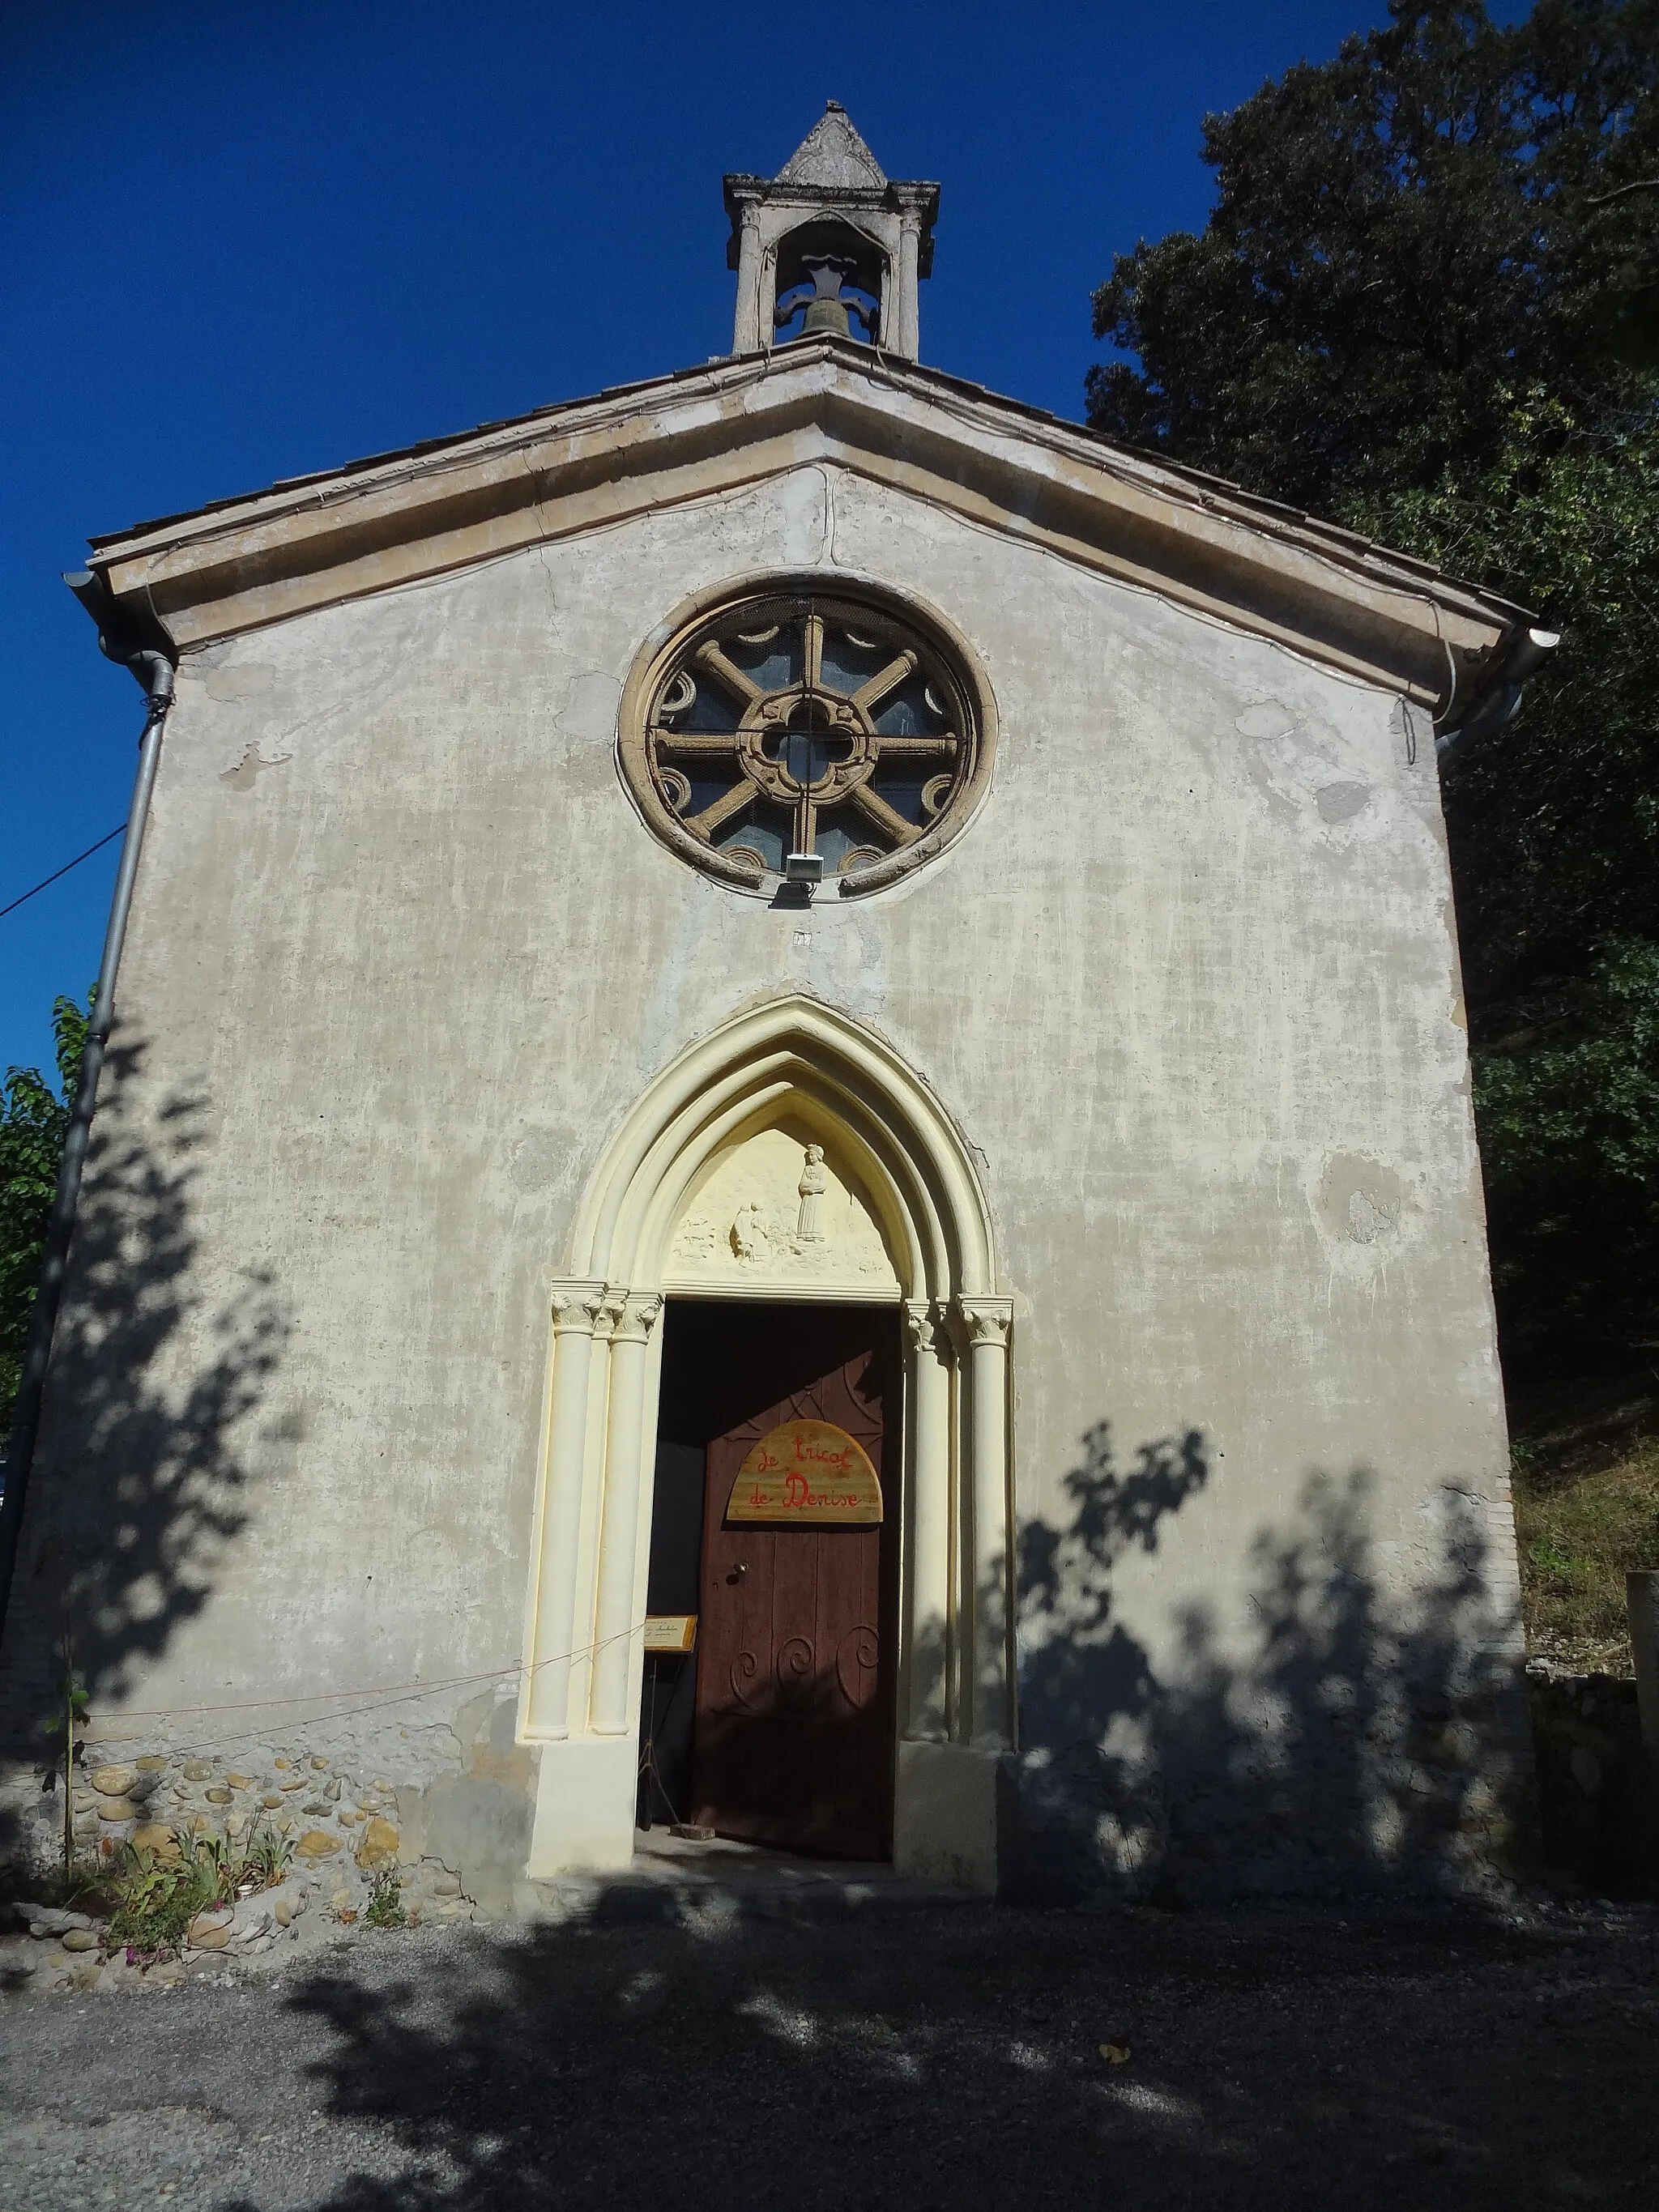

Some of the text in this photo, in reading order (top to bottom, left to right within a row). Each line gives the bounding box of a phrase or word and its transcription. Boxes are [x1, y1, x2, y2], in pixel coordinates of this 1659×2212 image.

[795, 1435, 852, 1469] tricot
[749, 1473, 862, 1507] de Denise
